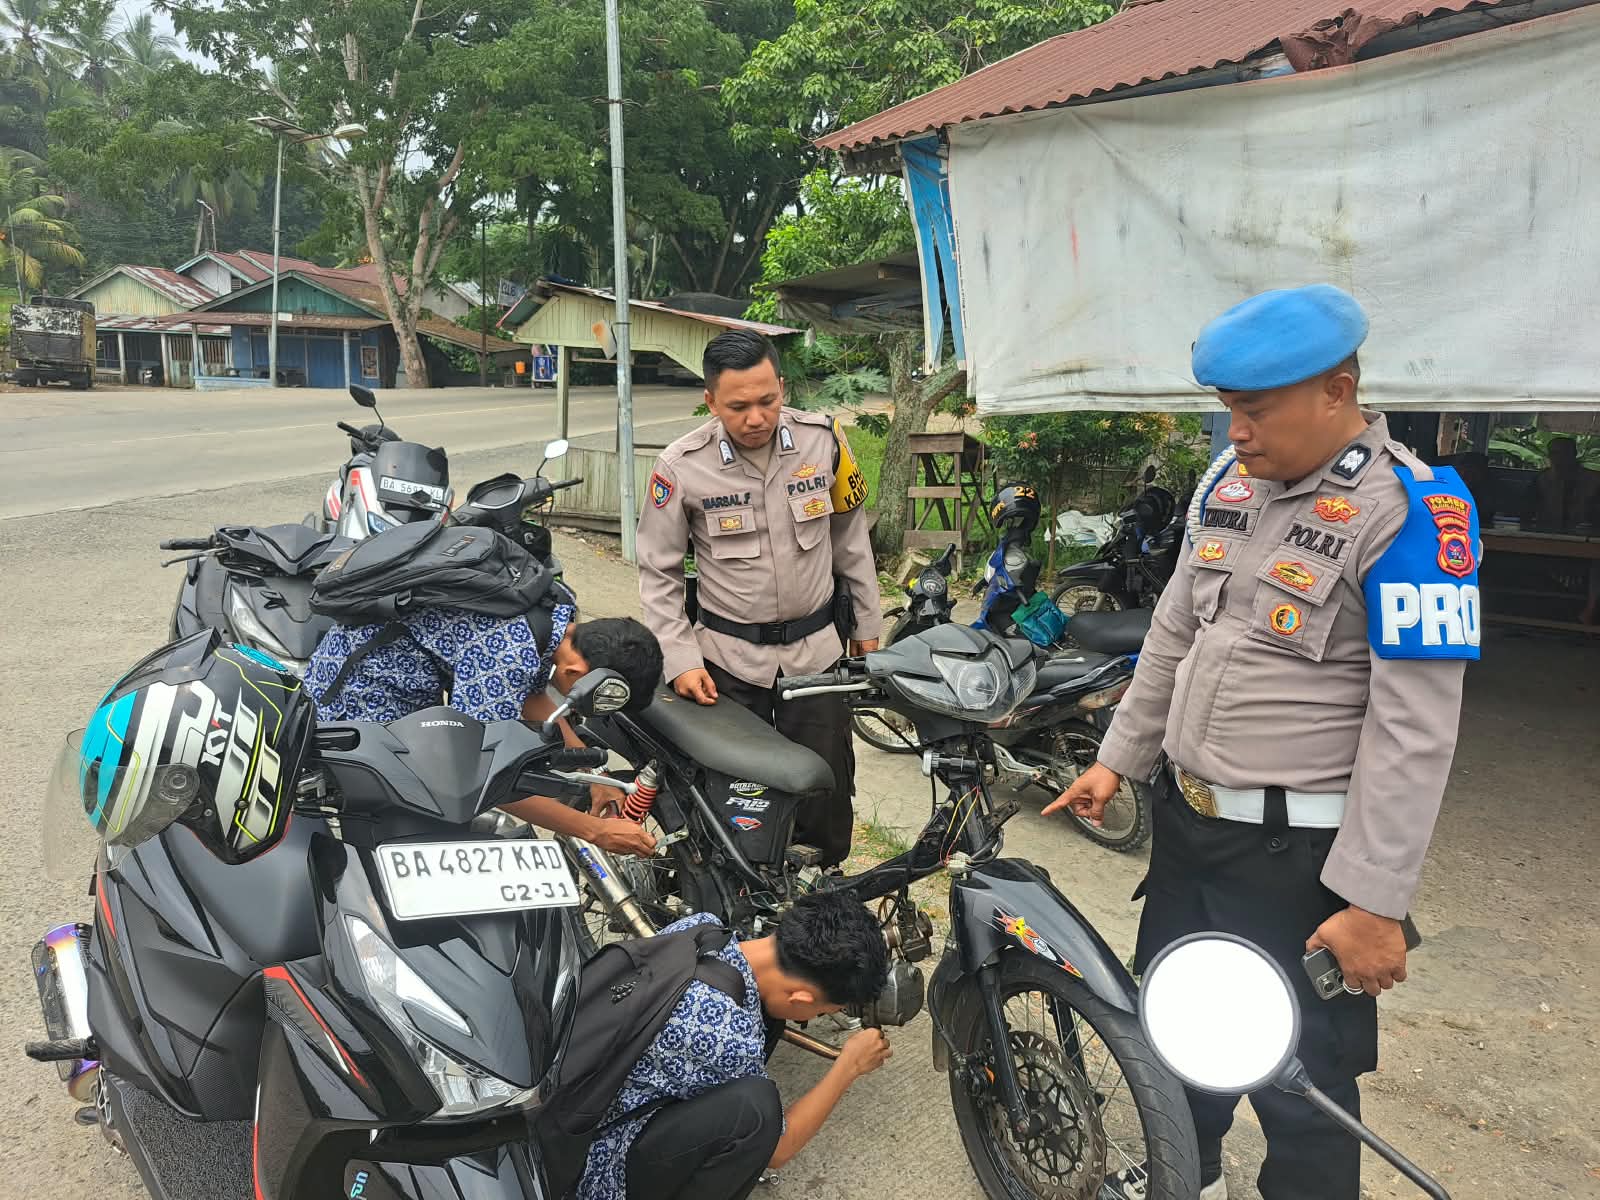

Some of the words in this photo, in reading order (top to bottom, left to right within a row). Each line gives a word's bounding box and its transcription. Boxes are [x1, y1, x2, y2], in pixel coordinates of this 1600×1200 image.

[383, 479, 395, 489] BA
[788, 476, 827, 496] POLRI
[1014, 486, 1035, 499] 22
[1284, 522, 1346, 560] POLRI
[201, 697, 233, 766] KYT
[420, 720, 465, 728] HONDA
[391, 851, 431, 878] BA
[439, 847, 504, 874] 4827
[512, 845, 562, 871] KAD
